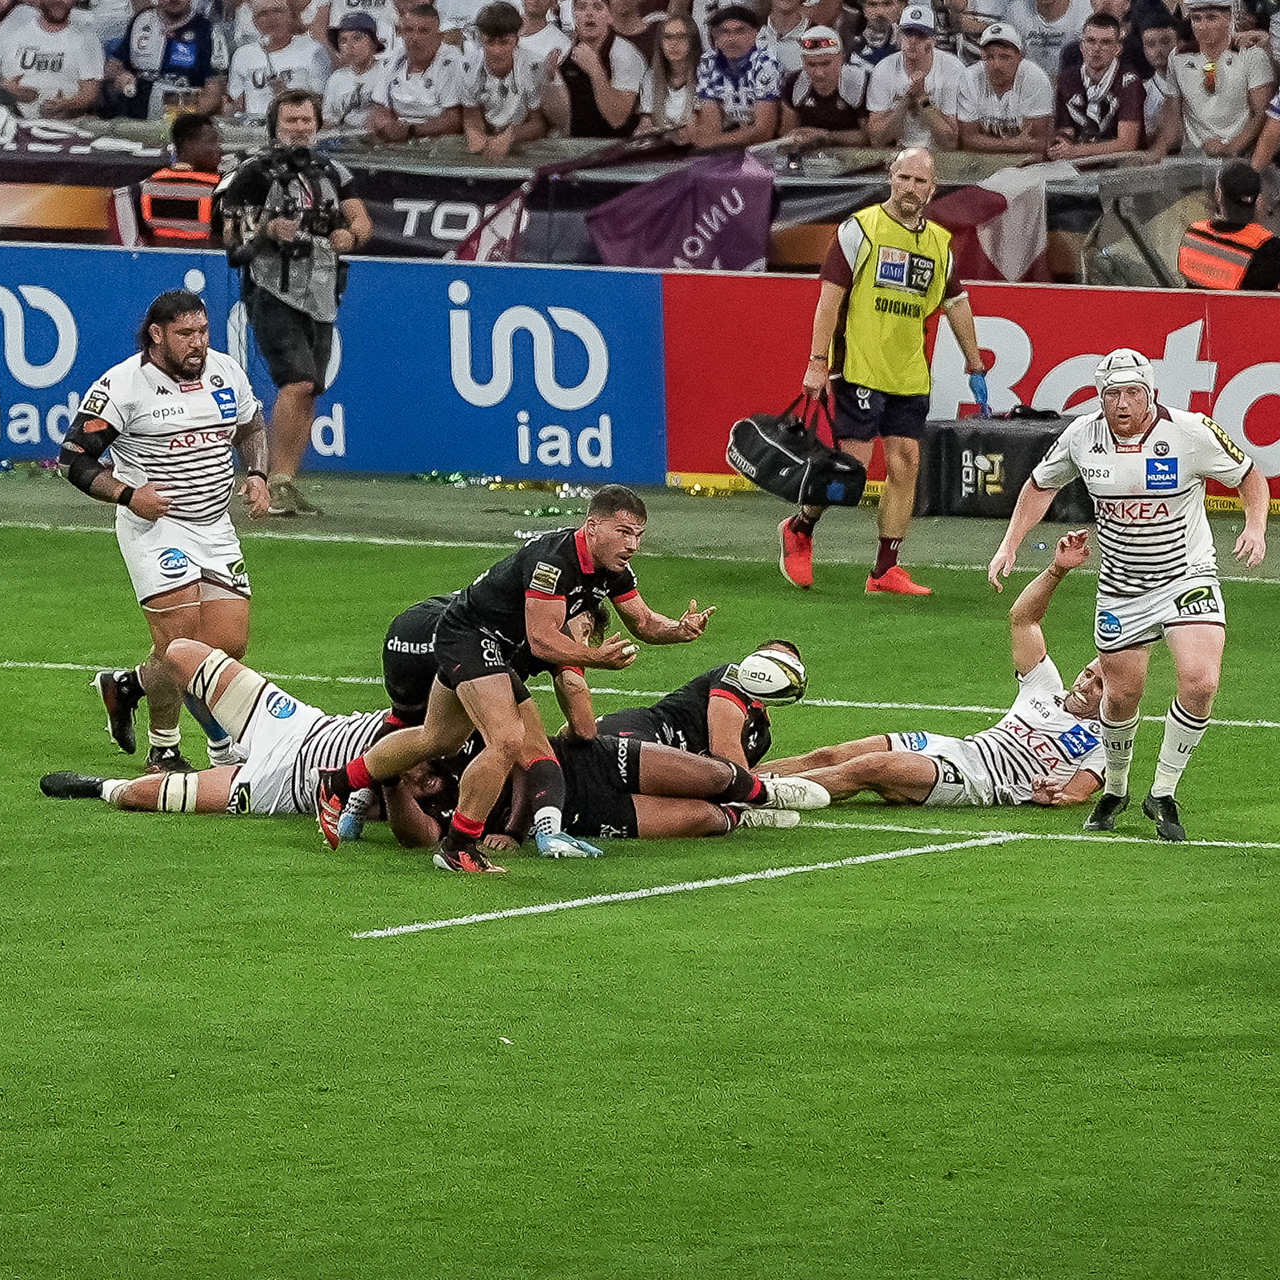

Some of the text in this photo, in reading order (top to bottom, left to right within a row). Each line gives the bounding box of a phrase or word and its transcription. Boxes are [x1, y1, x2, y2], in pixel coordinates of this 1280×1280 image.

[393, 199, 495, 240] TO
[152, 406, 185, 420] epsa
[515, 411, 613, 468] iad
[962, 449, 976, 498] TOP
[387, 635, 436, 654] chauss
